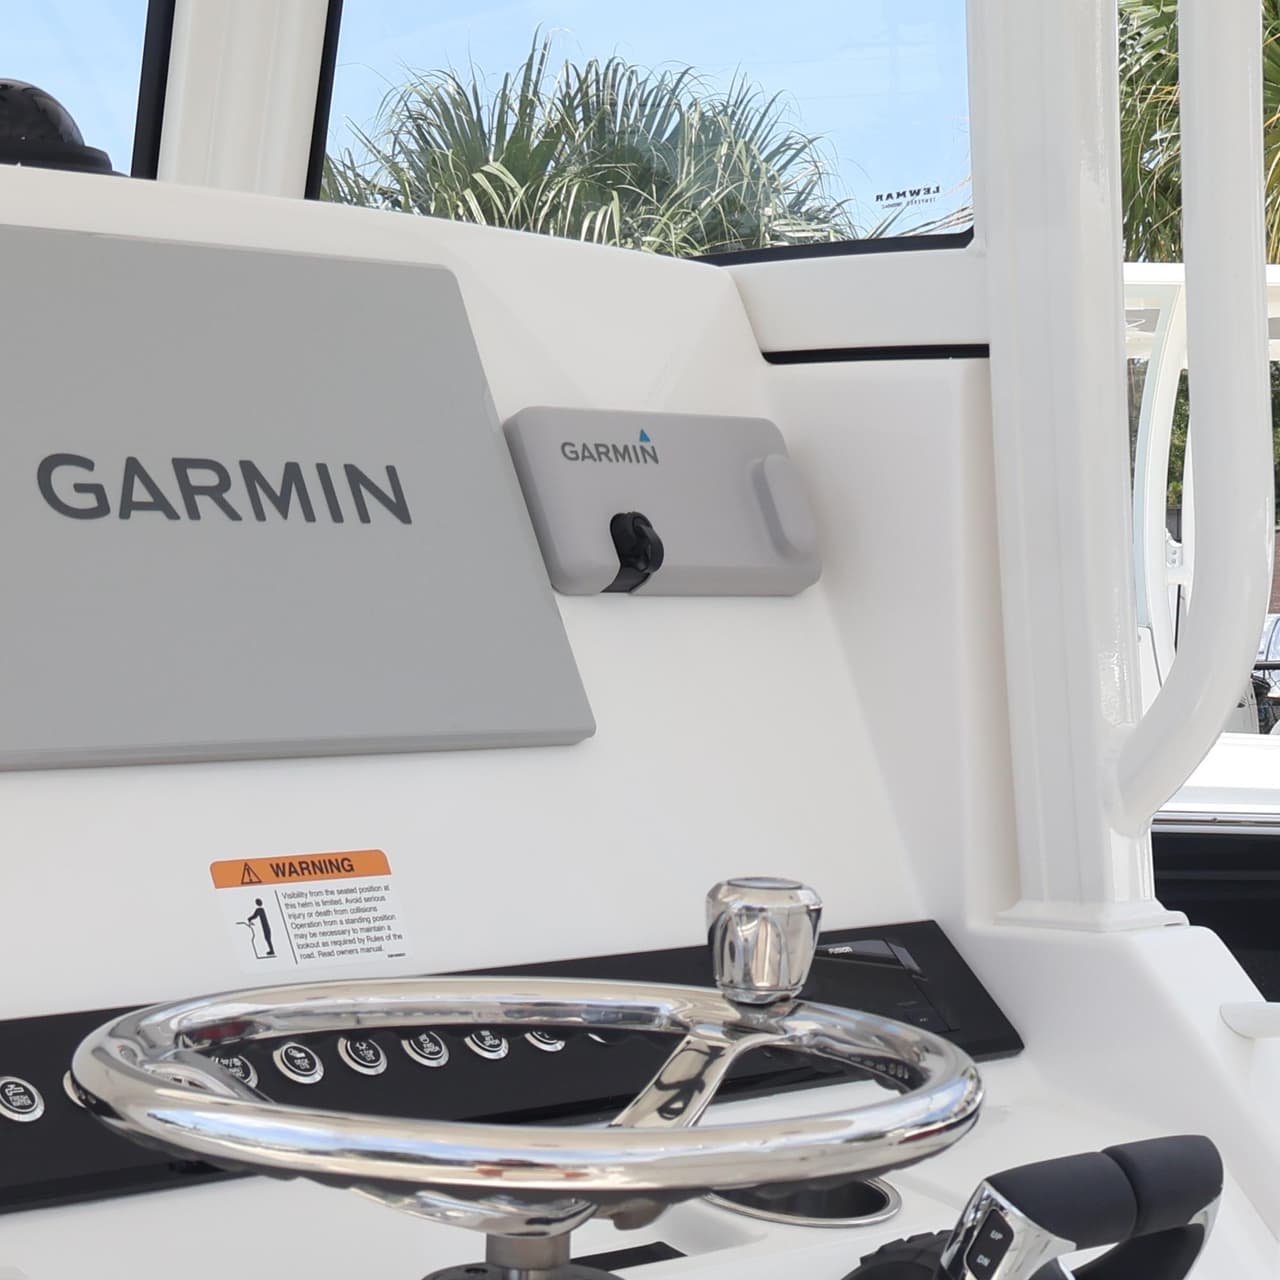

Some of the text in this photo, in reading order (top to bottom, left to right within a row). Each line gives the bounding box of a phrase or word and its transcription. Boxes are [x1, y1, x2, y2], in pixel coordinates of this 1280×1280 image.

[561, 441, 660, 465] GARMIN
[37, 452, 413, 525] GARMIN
[269, 857, 355, 878] WARNING
[281, 891, 308, 900] Visibility
[308, 890, 324, 898] from
[336, 887, 358, 896] seated
[358, 885, 383, 895] position
[284, 895, 386, 910] this helm is limited. Avoid serious
[287, 912, 305, 921] injury
[314, 909, 333, 917] death
[349, 906, 377, 914] collisions
[290, 921, 322, 930] Operation
[322, 919, 338, 927] from
[344, 916, 371, 925] standing
[371, 914, 396, 924] position
[318, 928, 351, 937] necessary
[359, 925, 386, 933] maintain
[296, 940, 320, 949] lookout
[330, 937, 356, 947] required
[356, 936, 365, 945] by
[365, 935, 384, 943] Rules
[384, 933, 392, 941] of
[299, 945, 383, 959] road. Read owners manual.
